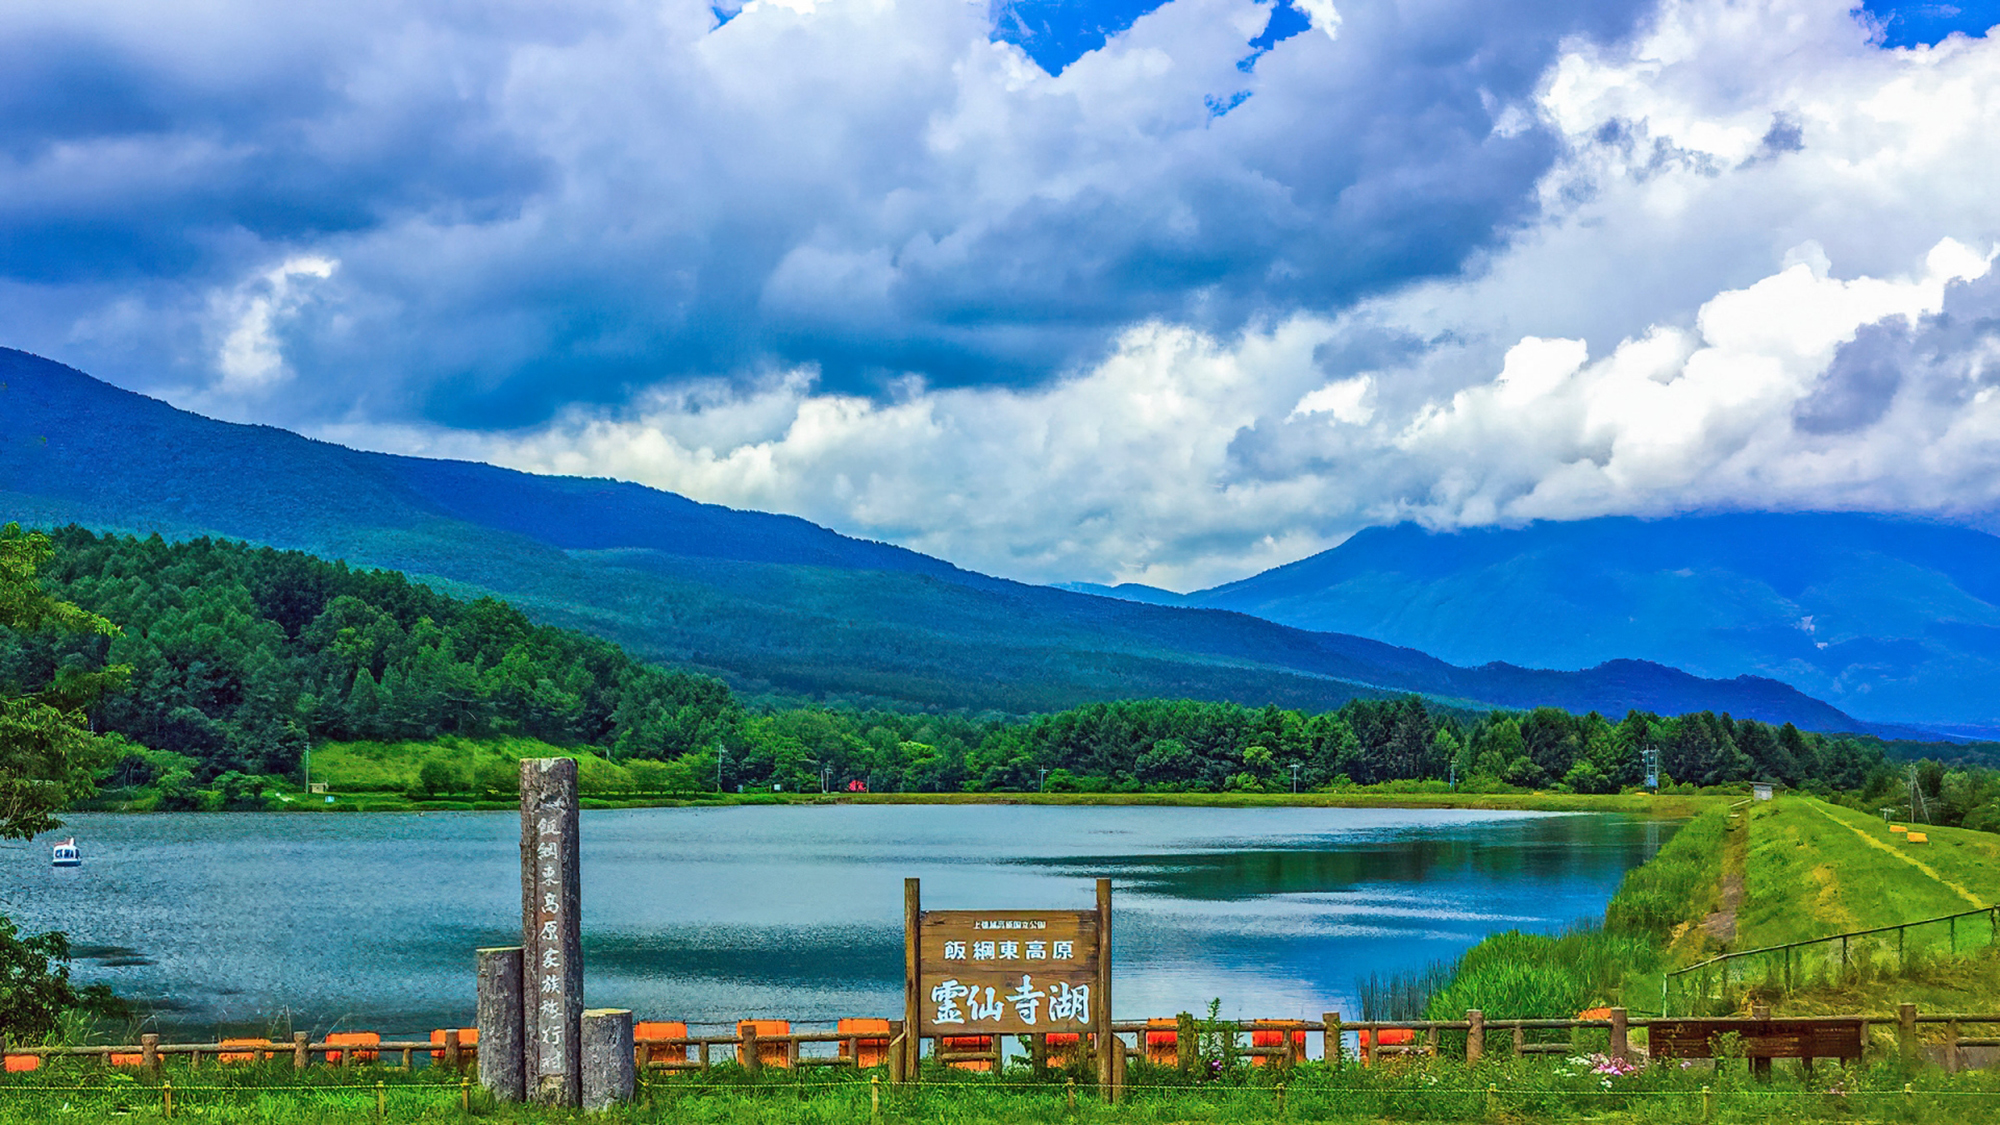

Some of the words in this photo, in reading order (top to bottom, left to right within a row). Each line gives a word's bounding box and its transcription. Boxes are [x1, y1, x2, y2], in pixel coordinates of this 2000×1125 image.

[944, 940, 1074, 960] 飯綱東高原
[930, 974, 1090, 1026] 霊仙寺湖
